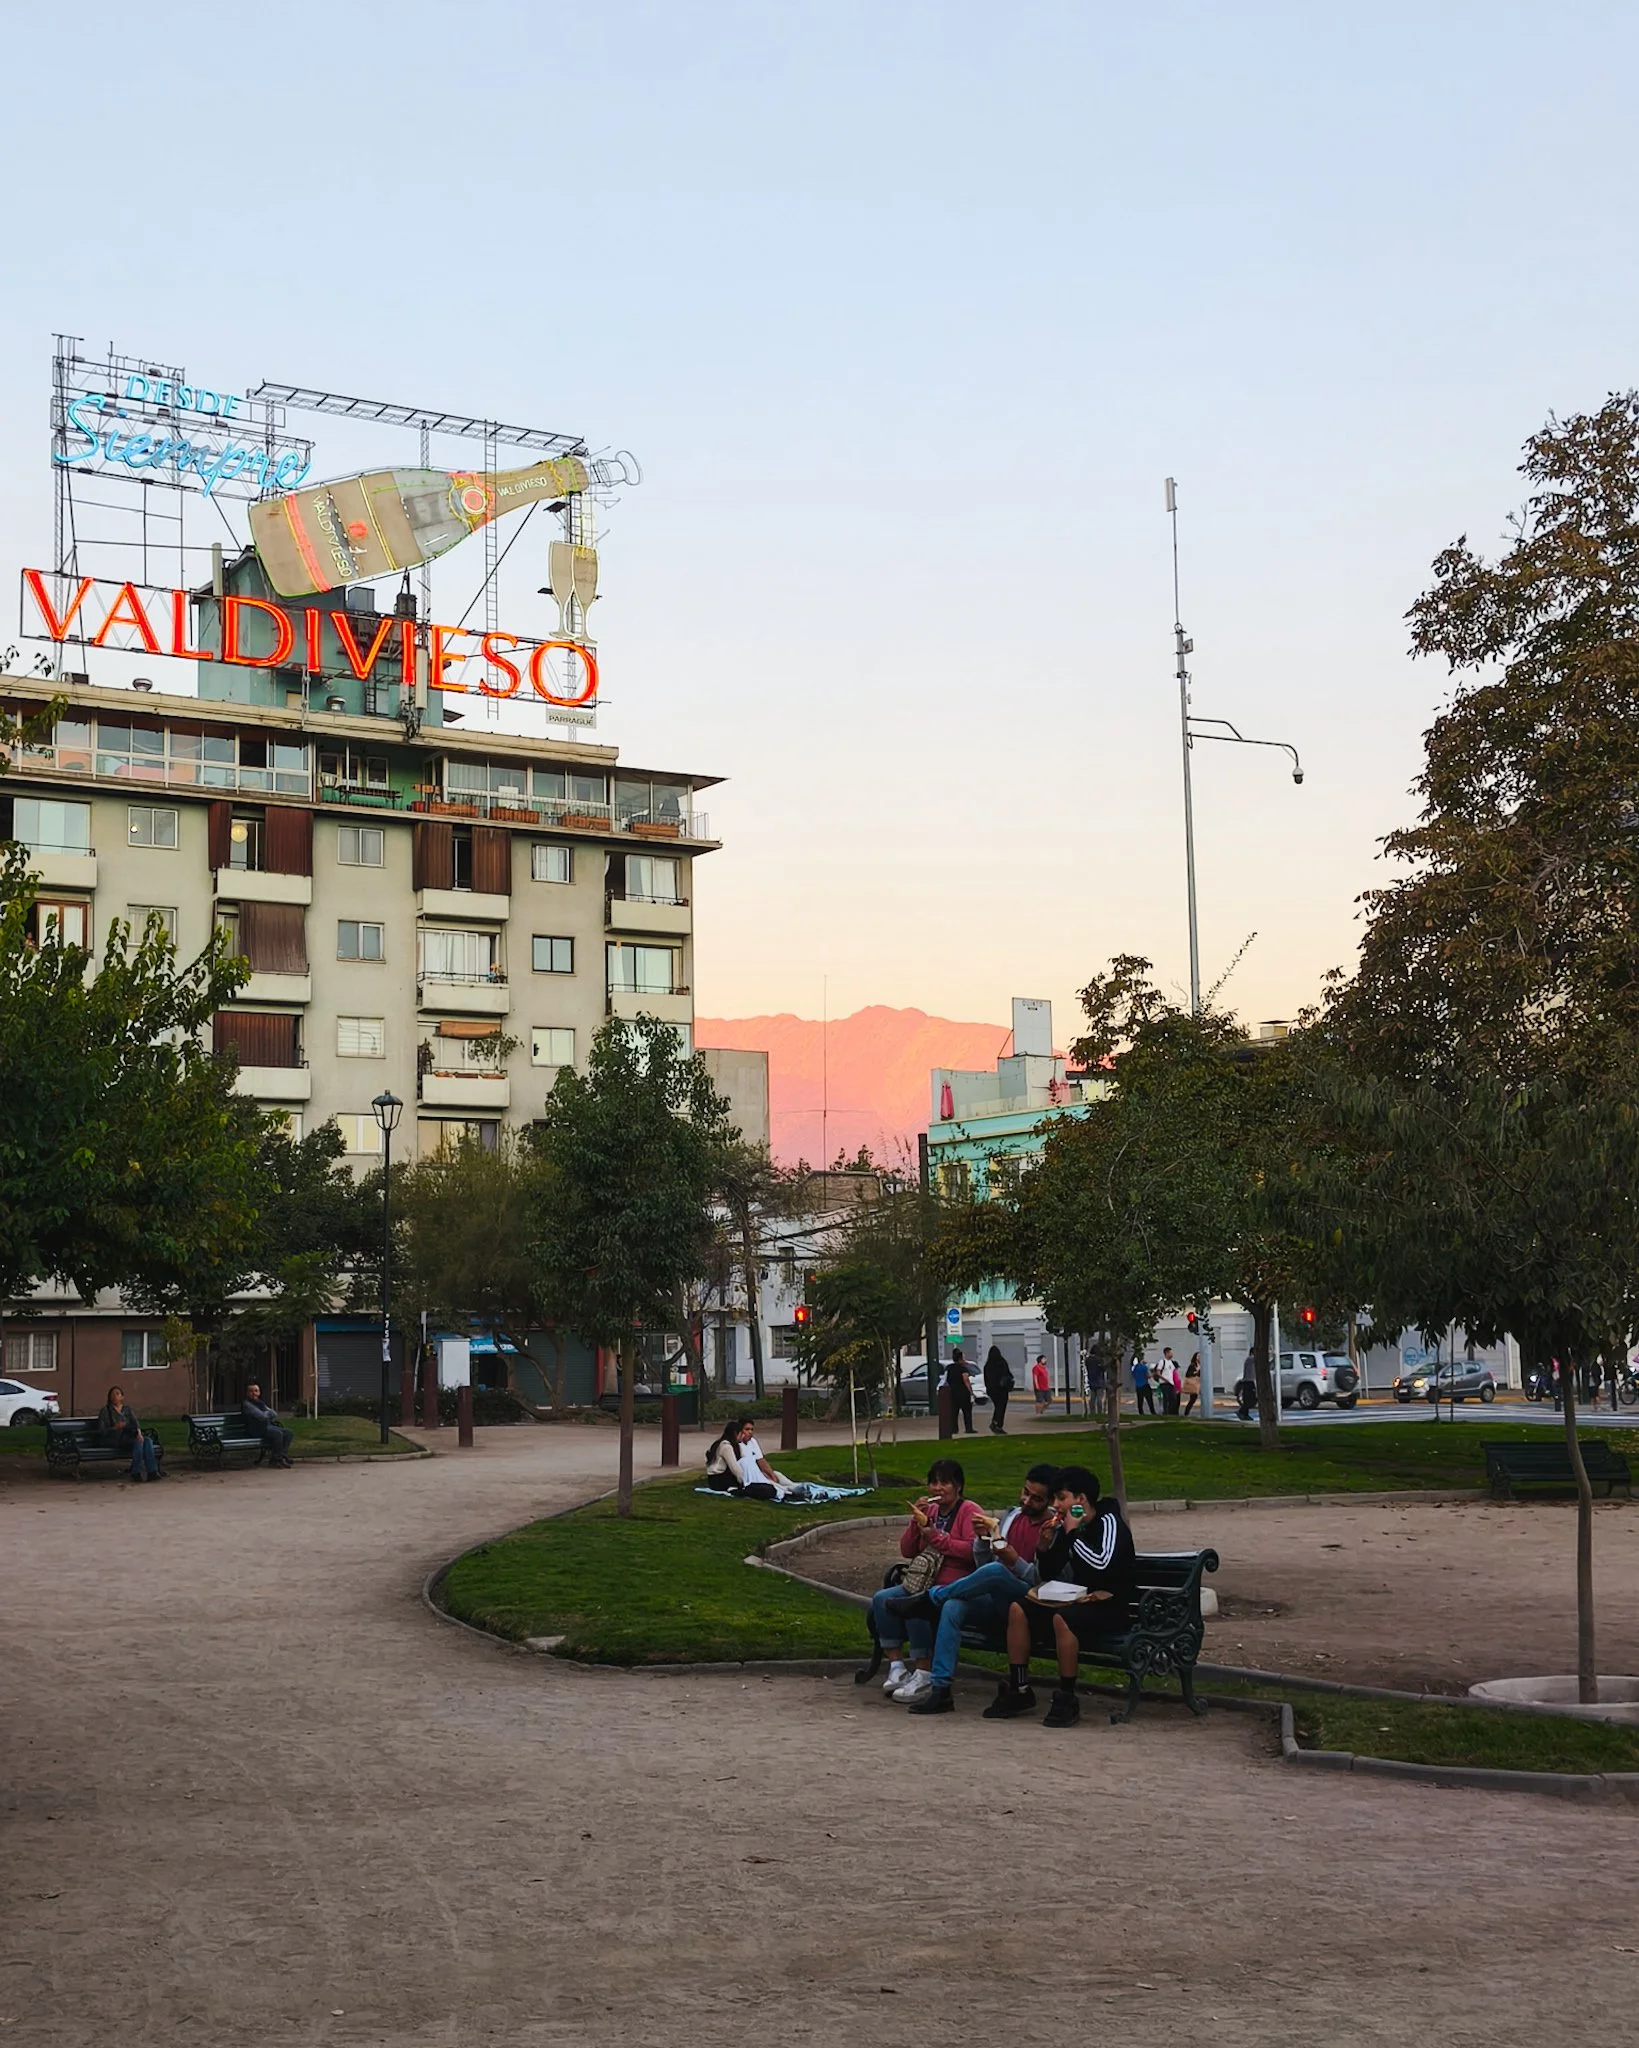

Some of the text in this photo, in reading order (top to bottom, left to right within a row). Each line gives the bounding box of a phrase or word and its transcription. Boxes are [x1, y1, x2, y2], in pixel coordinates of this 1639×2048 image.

[126, 375, 243, 418] DESDE
[54, 394, 312, 497] Siempre
[497, 476, 548, 497] VALDIVIESO
[313, 494, 353, 578] VALDIVIESO
[22, 568, 599, 707] VALDIVIESO
